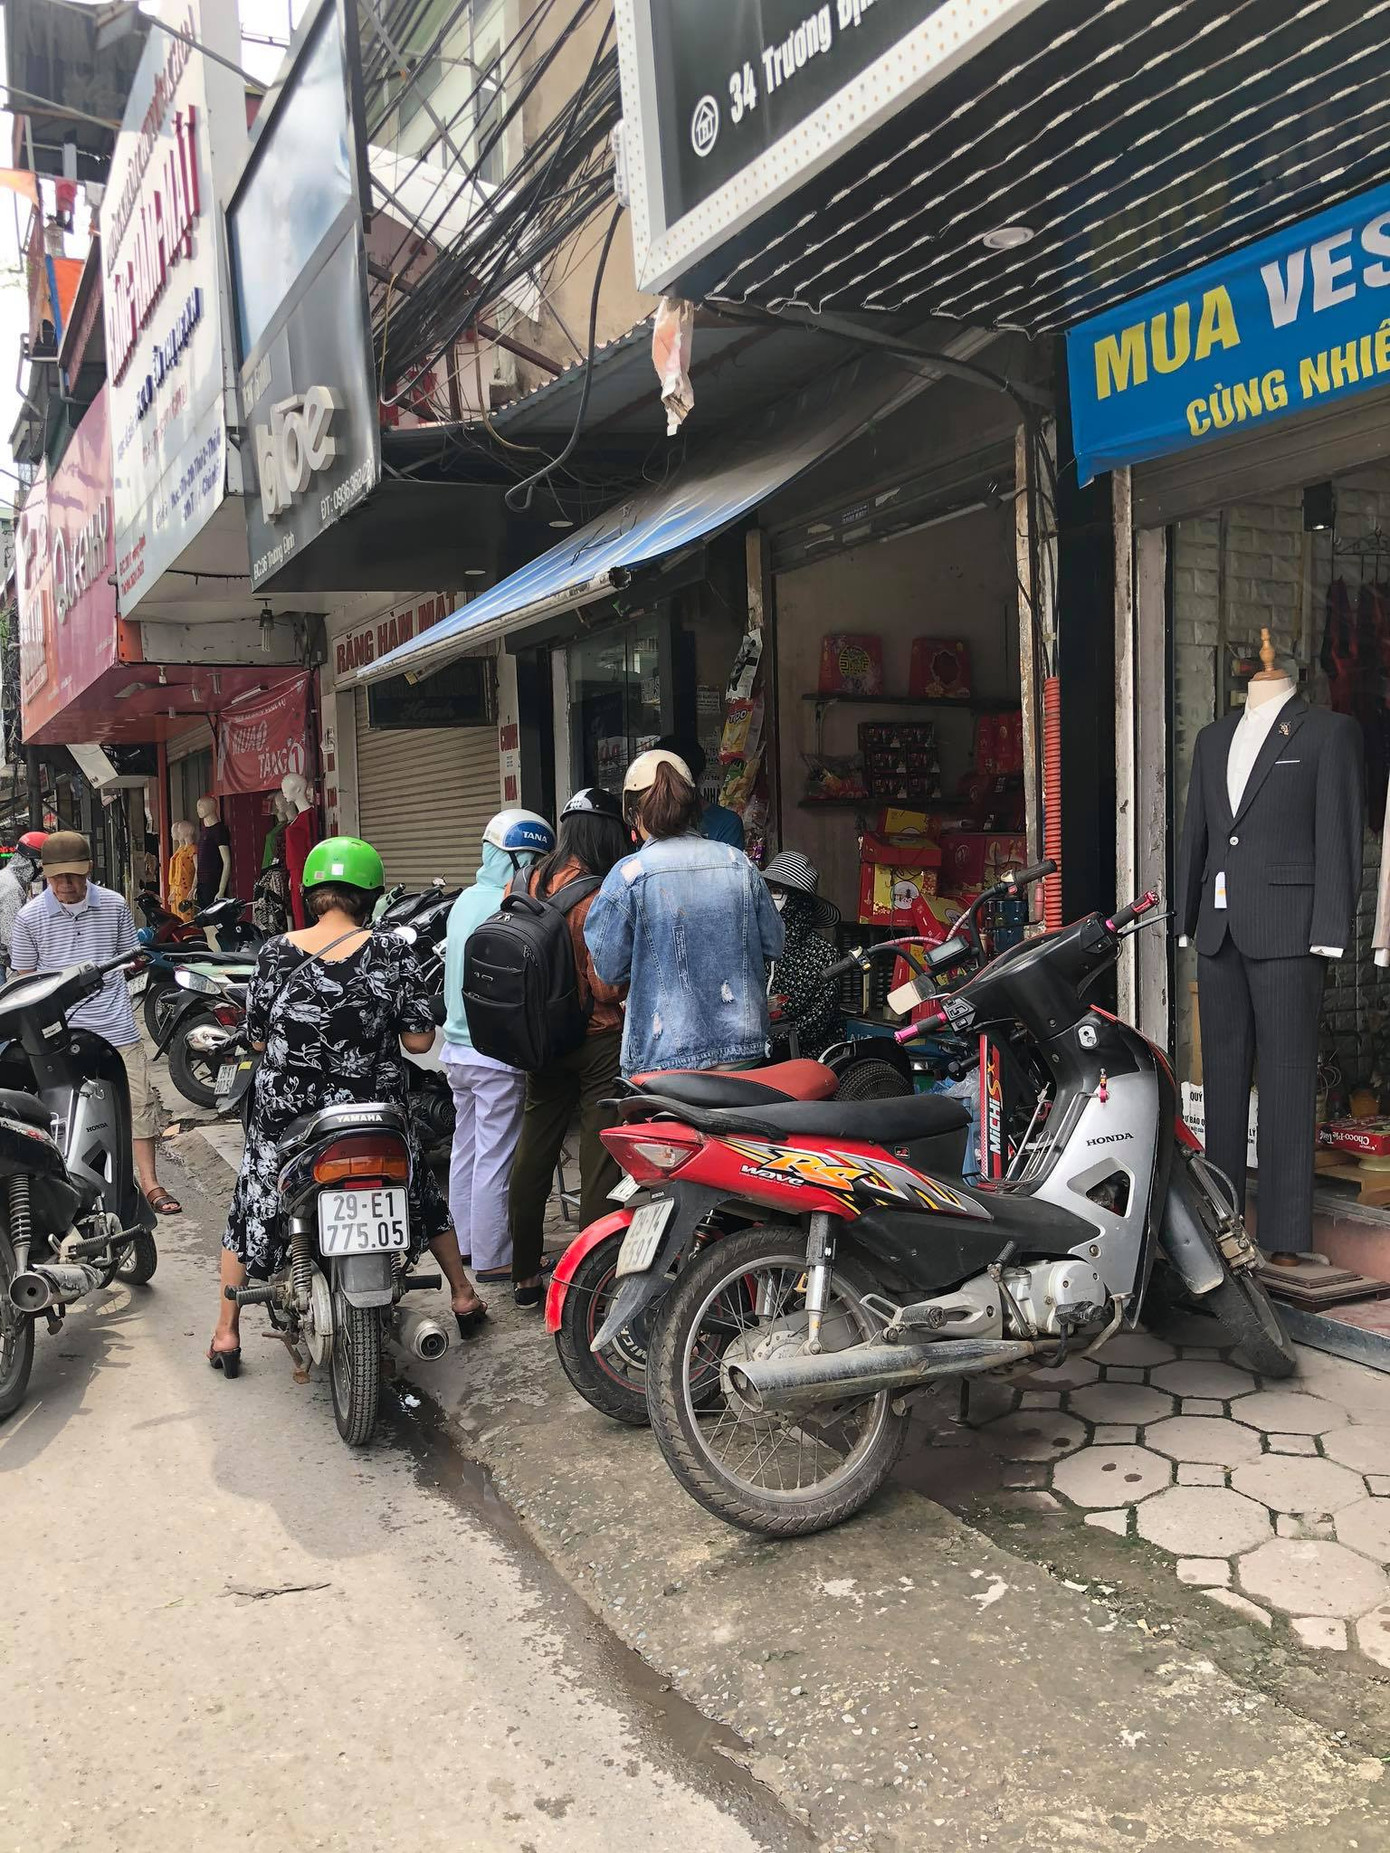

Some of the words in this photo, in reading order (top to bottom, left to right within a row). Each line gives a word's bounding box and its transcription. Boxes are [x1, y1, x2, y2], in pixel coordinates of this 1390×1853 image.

[729, 60, 757, 123] 34
[761, 3, 831, 95] Trương
[1094, 285, 1241, 400] MUA
[1186, 369, 1289, 437] CÙNG
[336, 630, 374, 676] RĂNG
[522, 830, 549, 844] TANA
[86, 1122, 109, 1133] HONDA
[336, 1114, 383, 1123] YAMAHA
[1086, 1132, 1135, 1147] HONDA
[333, 1191, 394, 1222] 29-E1
[327, 1220, 405, 1251] 775.05
